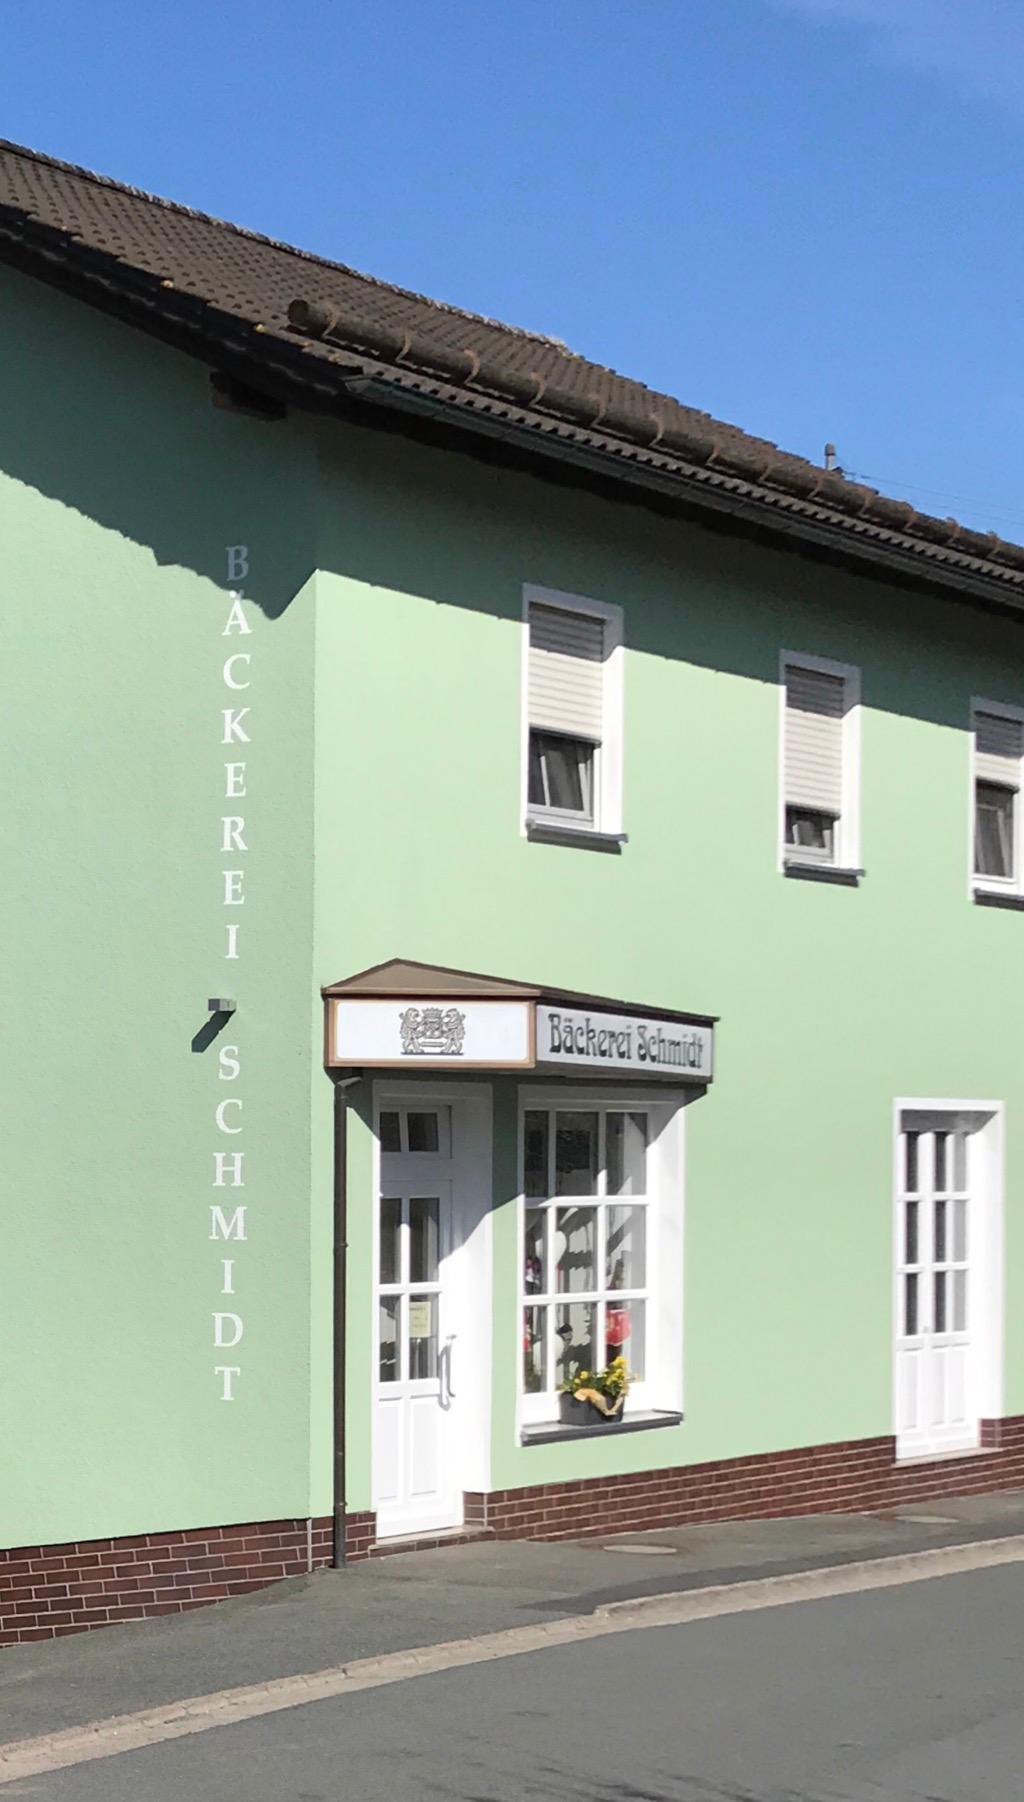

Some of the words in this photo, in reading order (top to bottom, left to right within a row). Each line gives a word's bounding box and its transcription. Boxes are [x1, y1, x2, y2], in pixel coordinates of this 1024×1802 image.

[548, 1013, 632, 1060] Bäckerei
[637, 1024, 703, 1068] Schmidt
[208, 1045, 248, 1401] SCHMIDT
